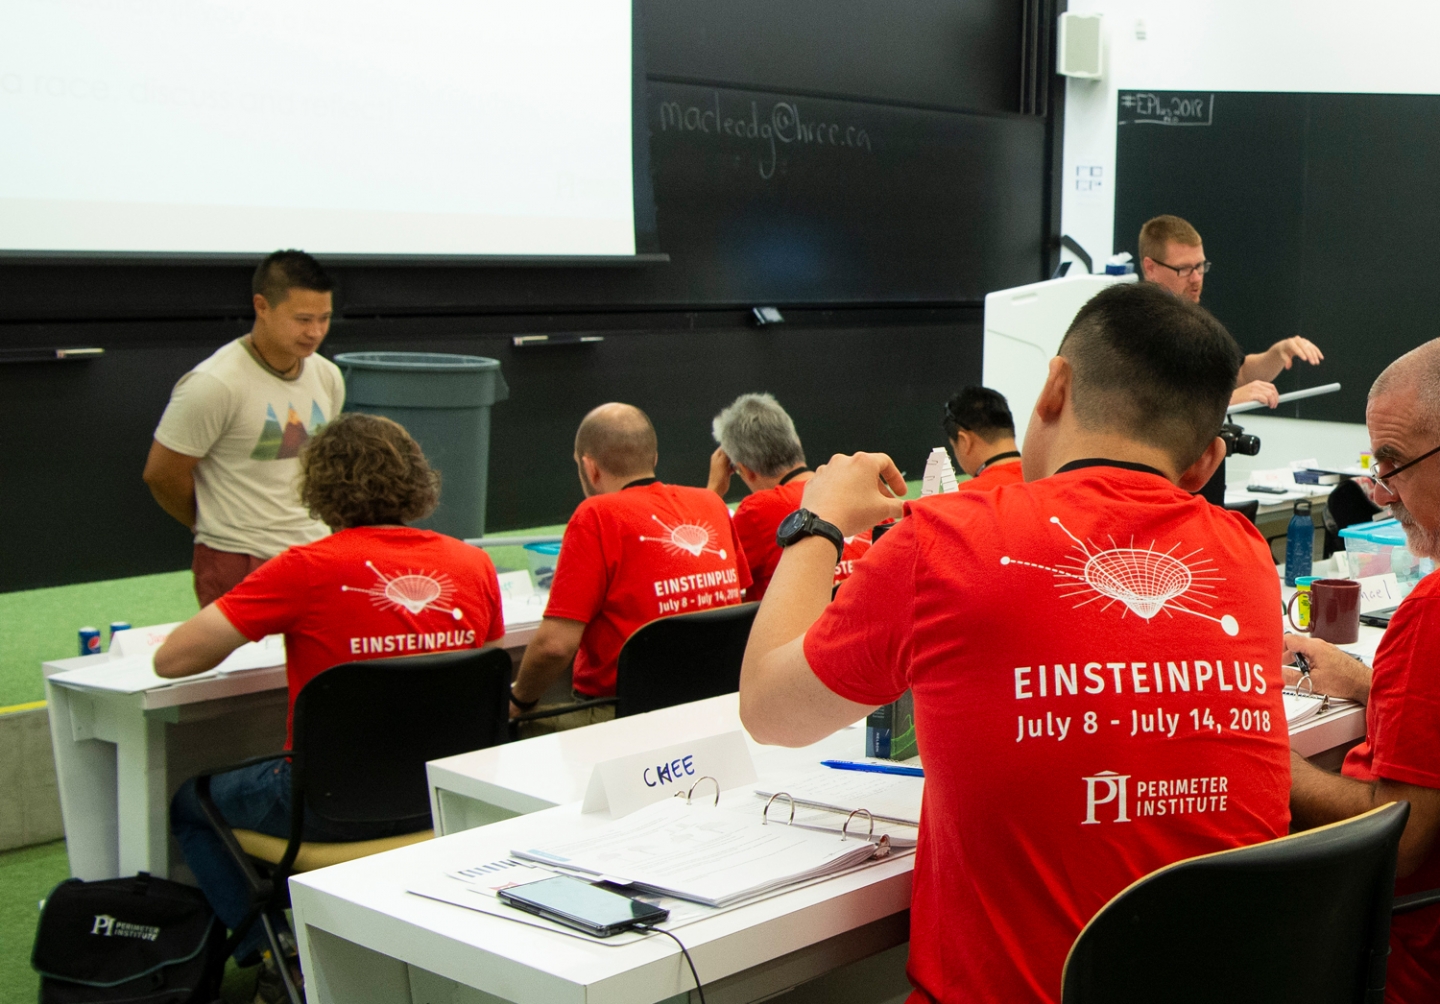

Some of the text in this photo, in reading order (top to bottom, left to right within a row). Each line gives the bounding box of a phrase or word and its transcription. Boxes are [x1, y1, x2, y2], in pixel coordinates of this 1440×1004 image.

[654, 568, 737, 597] EINSTEINPLUS
[659, 598, 680, 615] July
[682, 597, 688, 608] 8
[698, 592, 712, 607] July
[350, 630, 476, 654] EINSTEINPLUS
[1014, 660, 1268, 700] EINSTEINPLUS
[1016, 711, 1072, 742] July
[1083, 711, 1098, 734] 8
[1130, 707, 1180, 738] July
[1189, 708, 1222, 734] 14,
[1229, 708, 1271, 732] 2018
[1081, 770, 1131, 825] PI
[1137, 776, 1228, 798] PERIMETER
[1137, 796, 1228, 817] INSTITUTE
[90, 914, 116, 936] PI
[114, 930, 158, 941] INSTITUTE
[116, 922, 160, 934] PERIMETER
